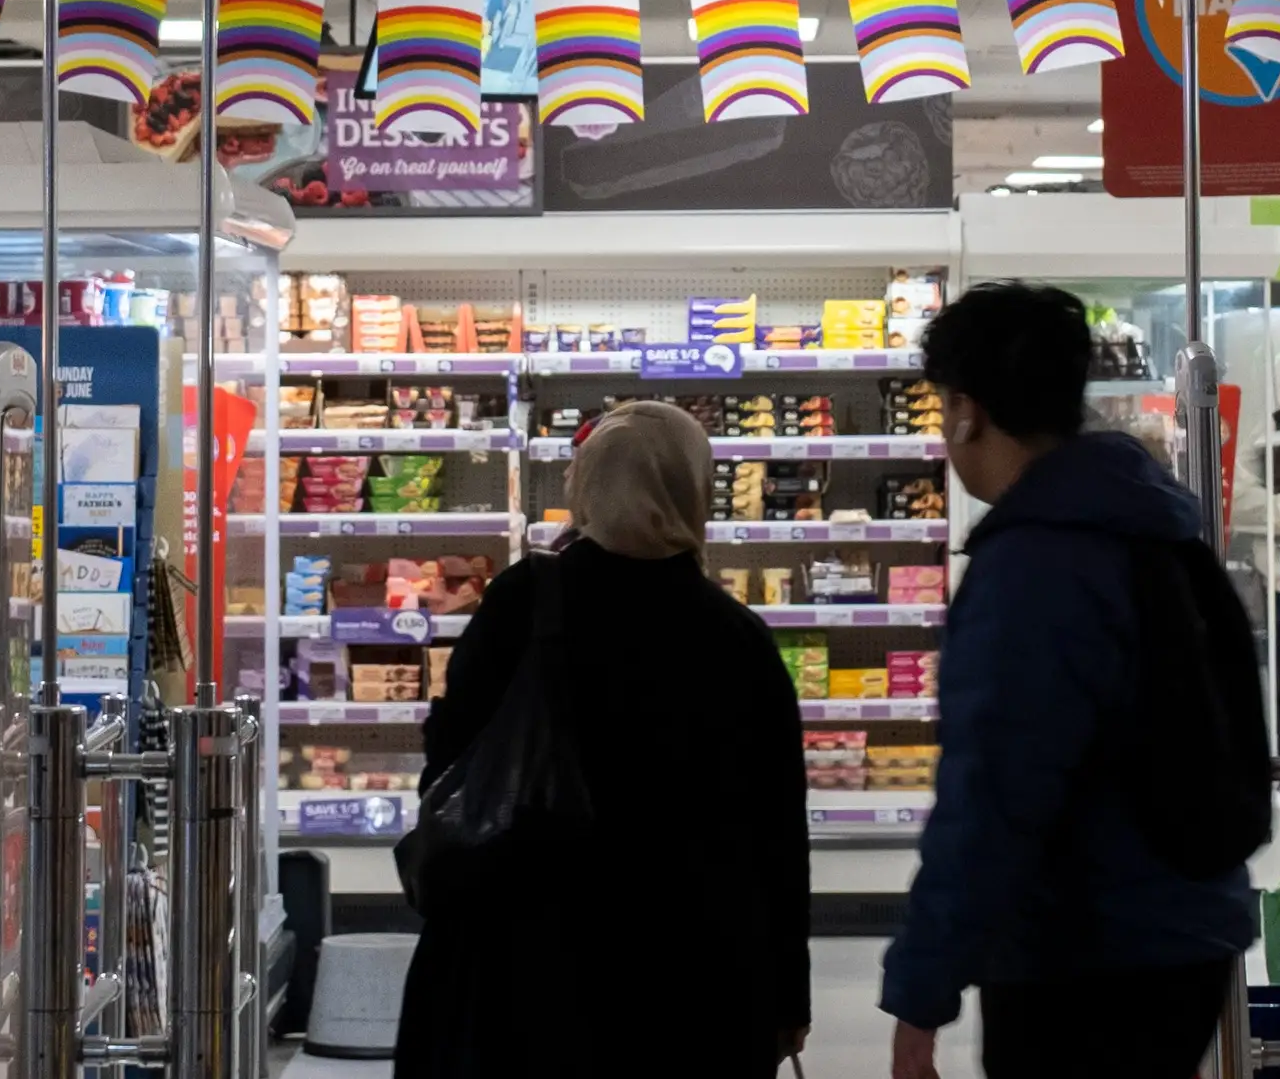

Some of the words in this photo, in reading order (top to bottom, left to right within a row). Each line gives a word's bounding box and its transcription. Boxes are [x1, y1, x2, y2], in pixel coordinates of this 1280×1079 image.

[340, 156, 367, 181] Go
[371, 161, 392, 175] on
[393, 157, 435, 176] treat
[437, 156, 508, 180] yourself
[57, 366, 94, 382] UNDAY
[65, 382, 93, 398] JUNE
